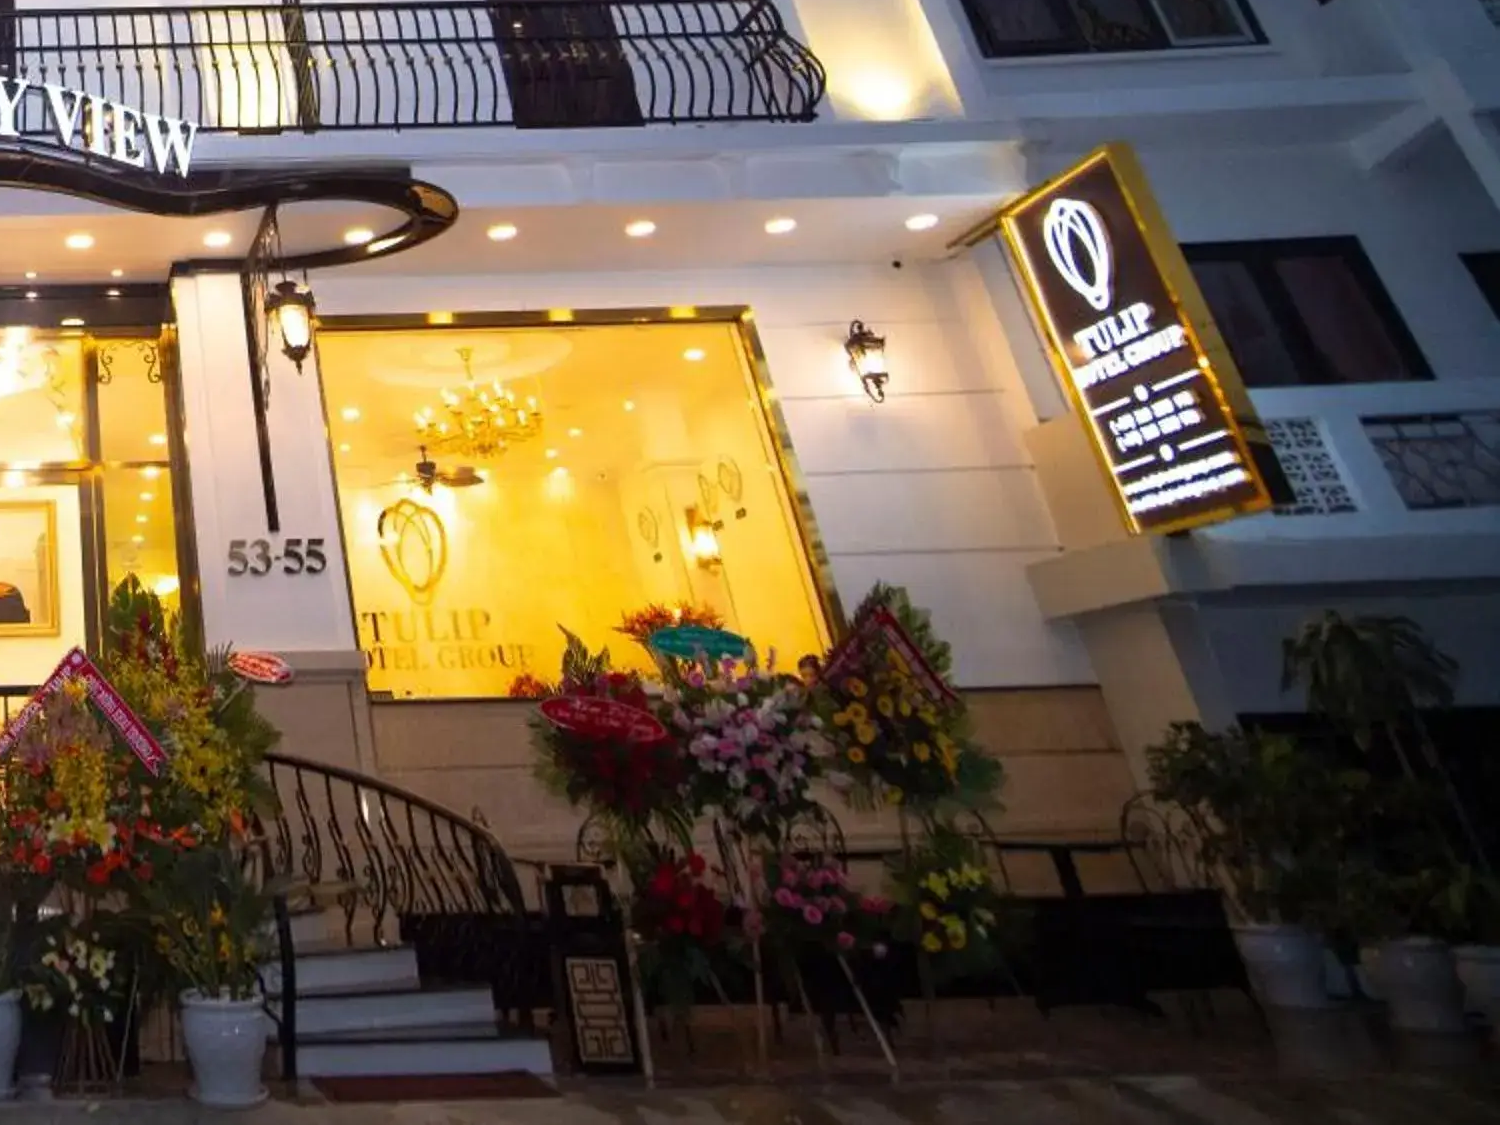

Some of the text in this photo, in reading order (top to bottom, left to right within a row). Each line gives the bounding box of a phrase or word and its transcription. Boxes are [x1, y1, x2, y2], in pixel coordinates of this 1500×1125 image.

[41, 83, 198, 178] VIEW
[1073, 302, 1153, 360] TULIP
[227, 538, 327, 575] 53-55
[362, 608, 490, 644] TULIP
[367, 644, 534, 670] TEL GROUP
